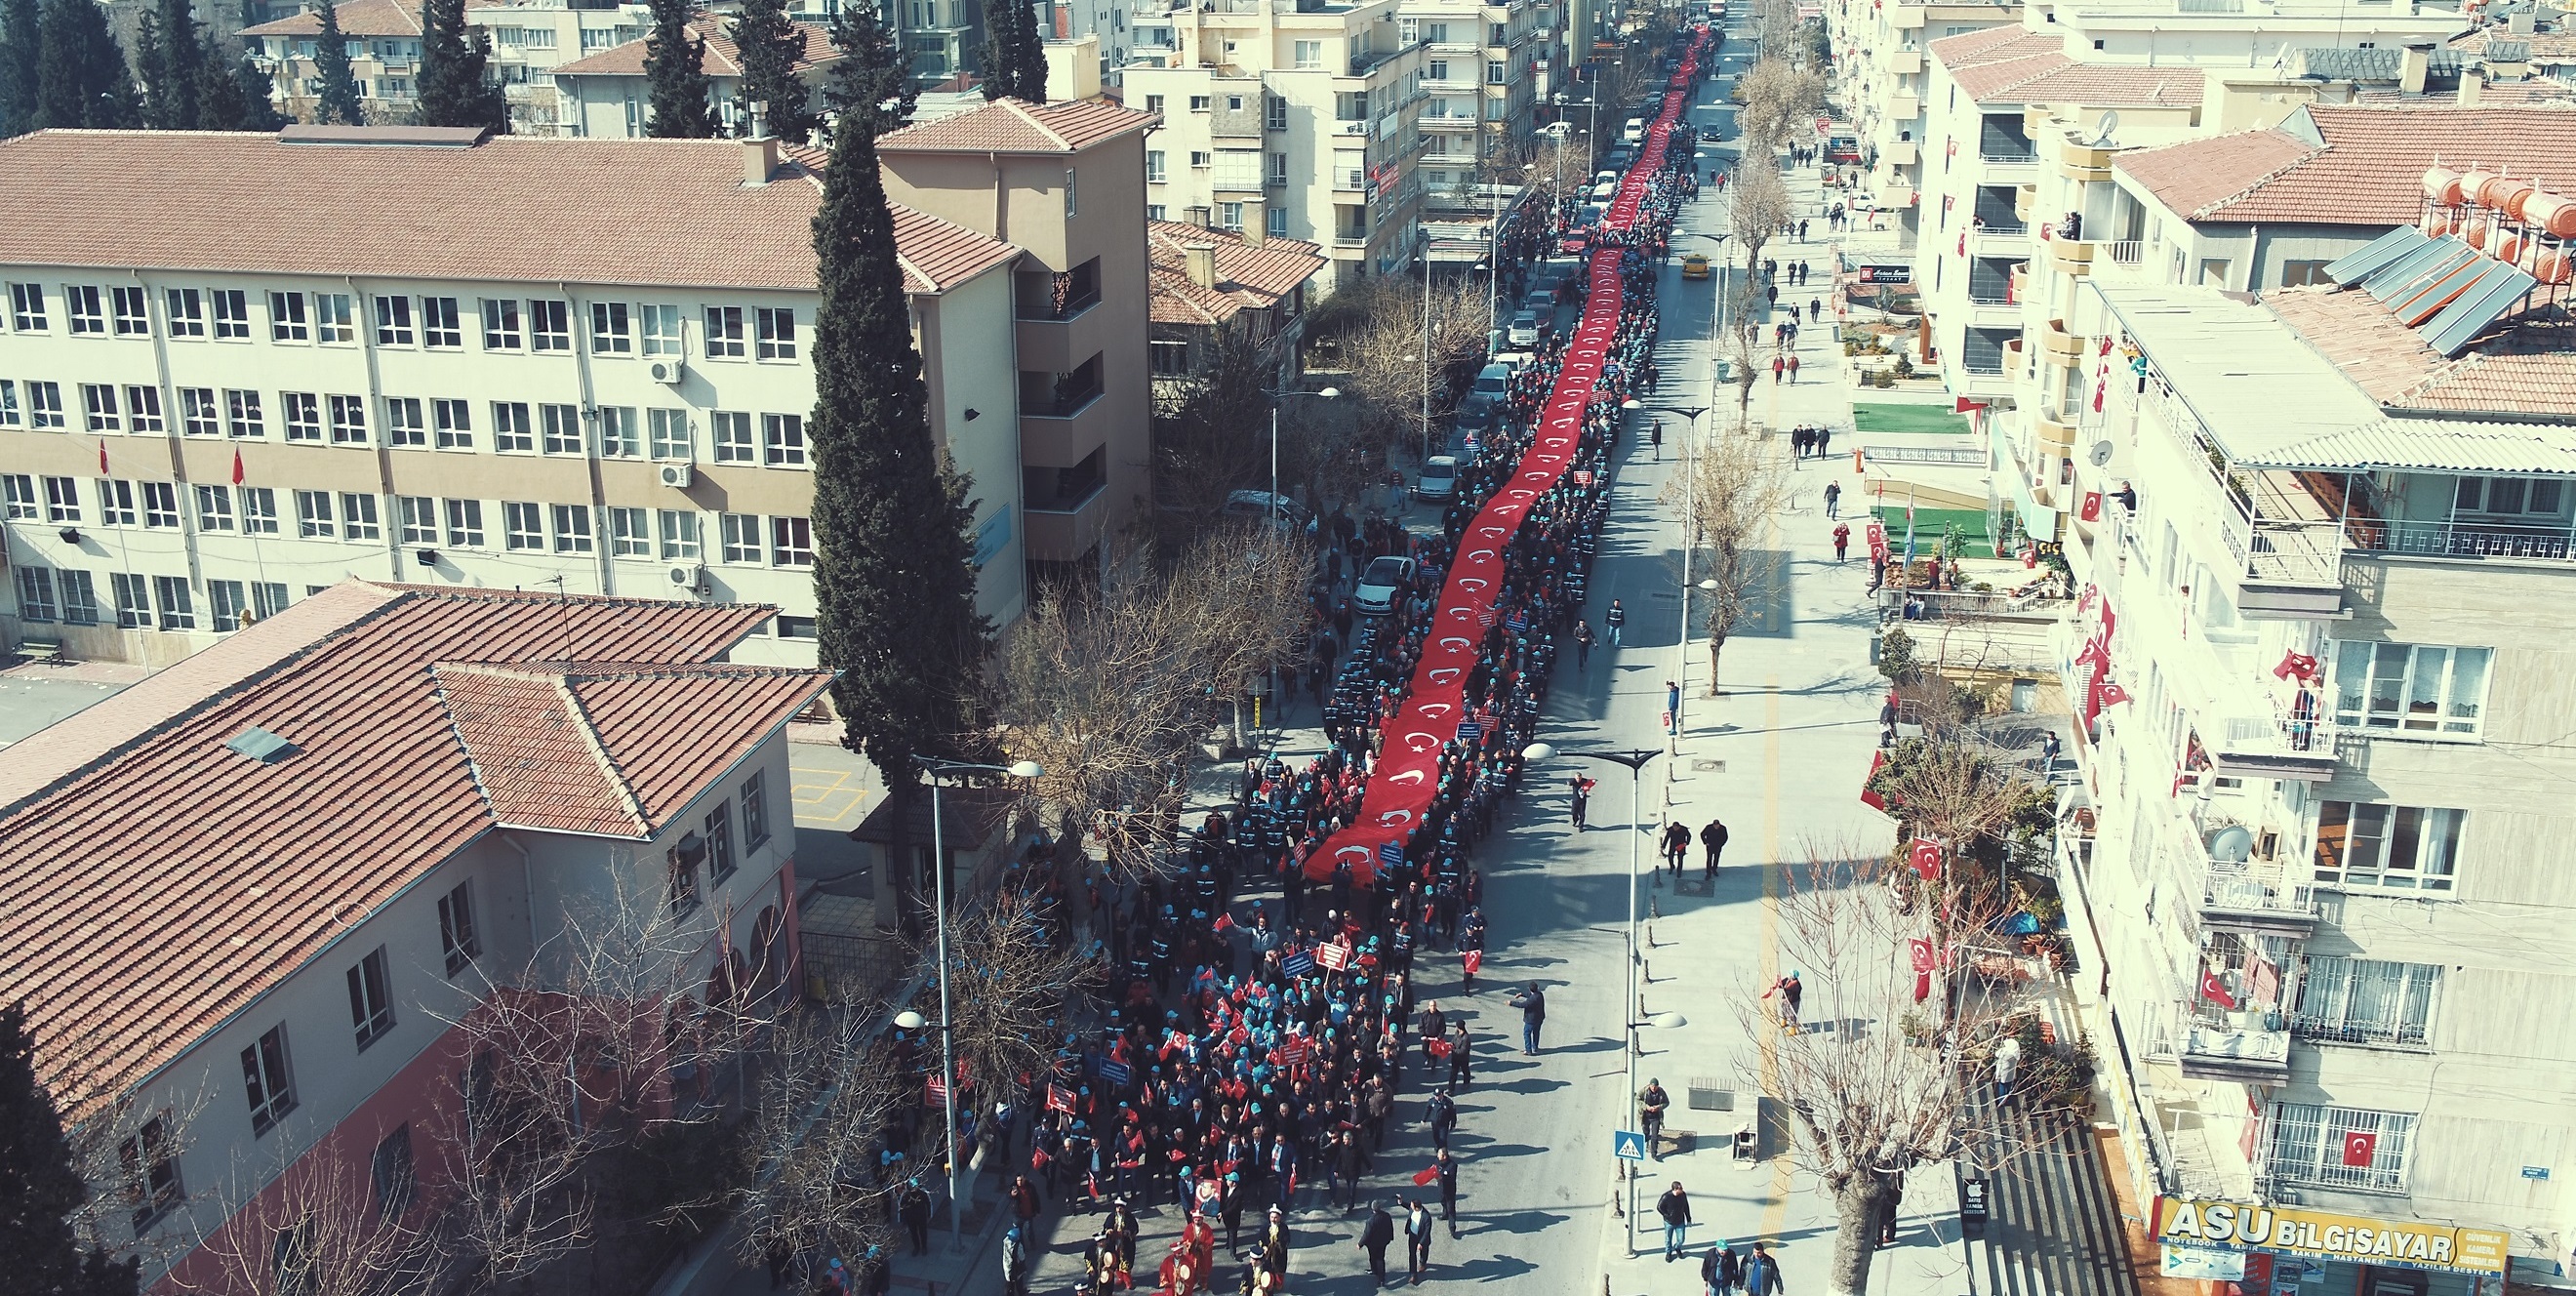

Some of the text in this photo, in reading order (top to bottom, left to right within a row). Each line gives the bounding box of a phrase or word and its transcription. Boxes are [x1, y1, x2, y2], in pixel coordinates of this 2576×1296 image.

[2166, 1202, 2274, 1244] ASU
[2167, 1237, 2218, 1247] NOTEBOOK
[2291, 1250, 2322, 1258] BAKIM
[2412, 1262, 2450, 1271] YAZILIM
[2453, 1267, 2492, 1276] DESTEK
[2466, 1244, 2496, 1256] KAMERA
